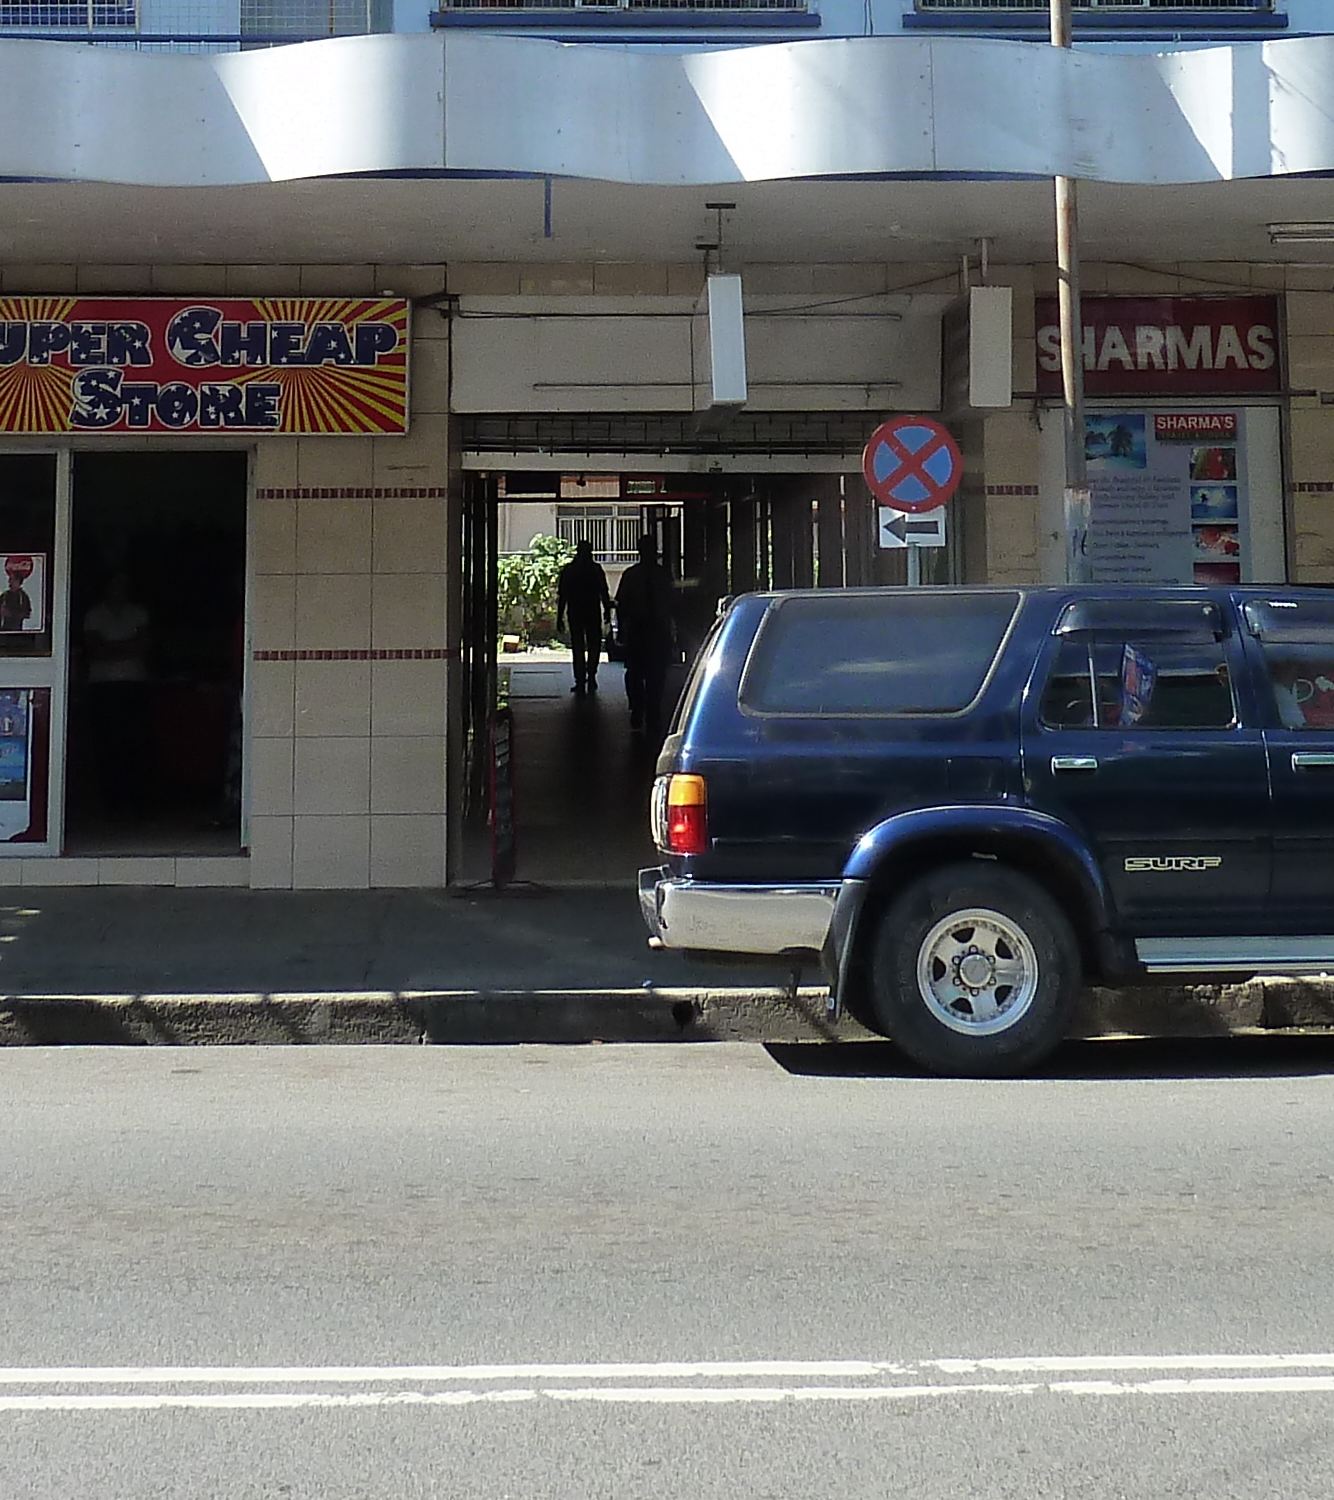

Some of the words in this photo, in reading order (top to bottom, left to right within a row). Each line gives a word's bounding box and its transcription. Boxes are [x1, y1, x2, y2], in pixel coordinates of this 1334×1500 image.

[167, 306, 399, 367] CHEAP
[69, 367, 282, 428] STORE
[1157, 416, 1234, 430] SHARMA'S
[1125, 857, 1222, 871] SURF
